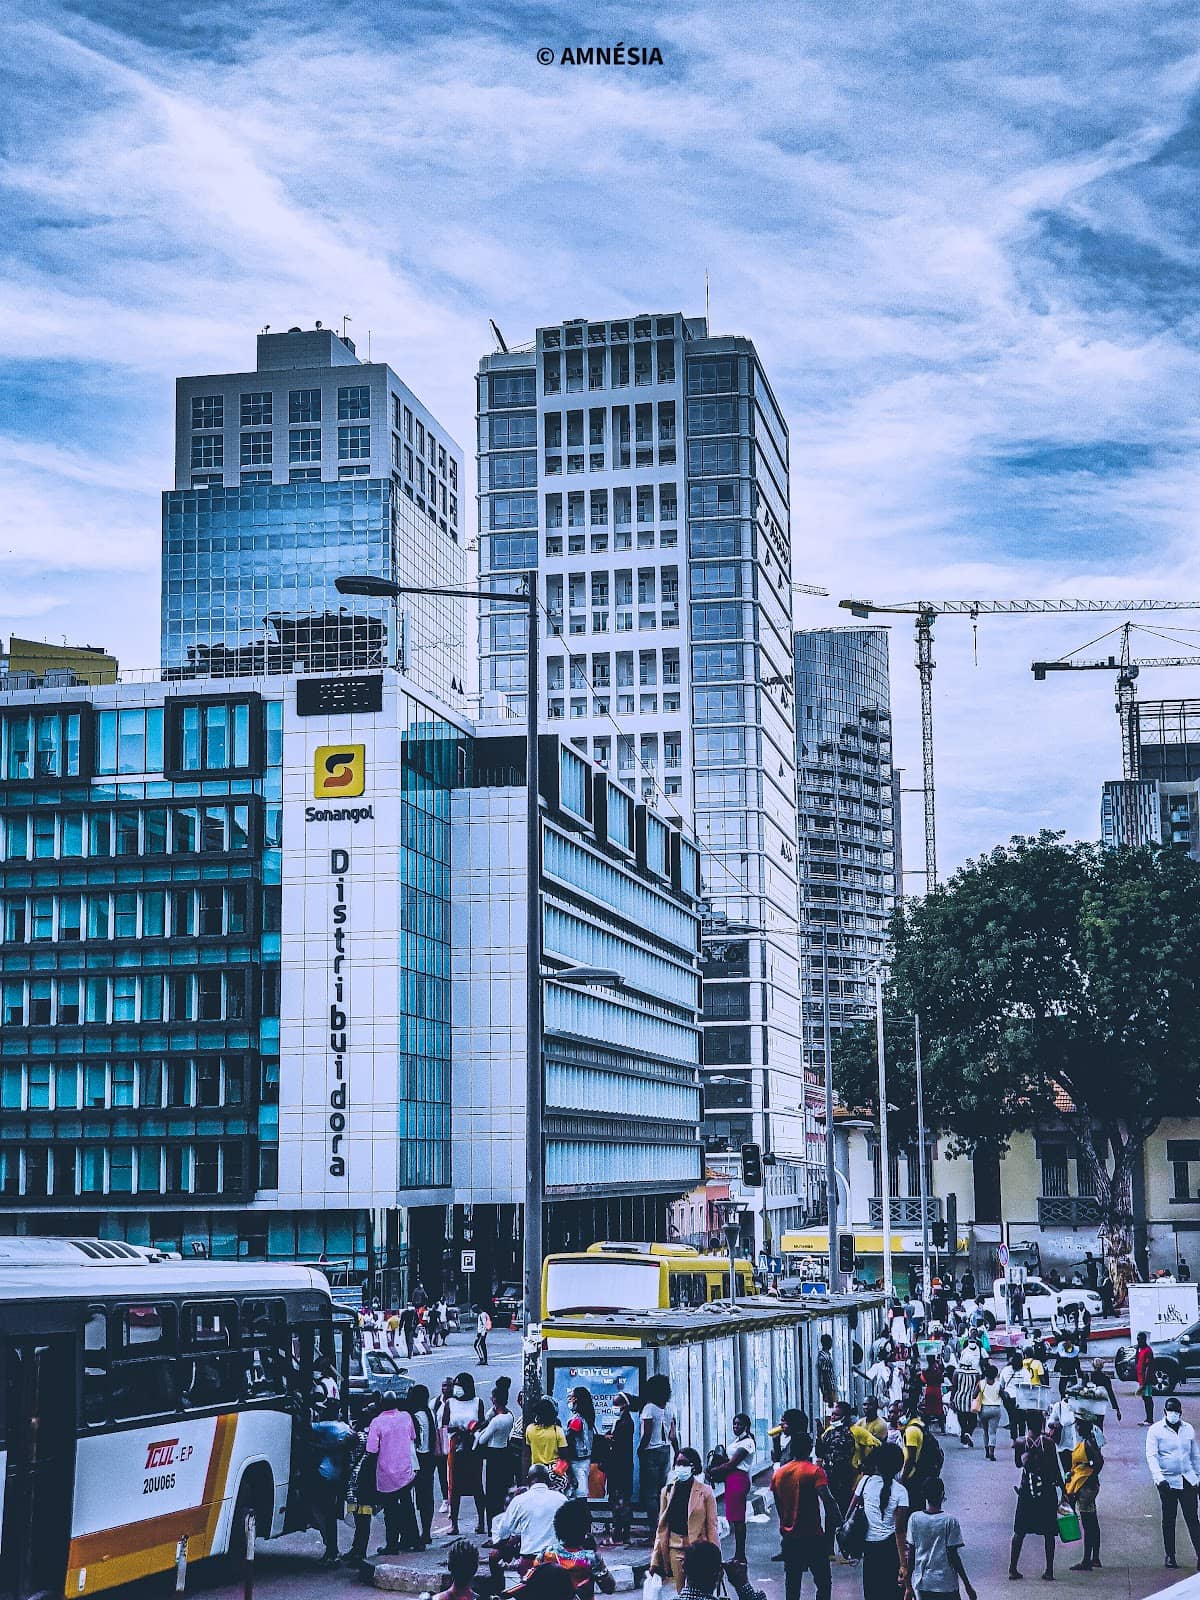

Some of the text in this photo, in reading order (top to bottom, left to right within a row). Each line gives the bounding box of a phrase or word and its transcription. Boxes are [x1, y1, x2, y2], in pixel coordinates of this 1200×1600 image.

[304, 804, 375, 824] Sonangol
[329, 848, 350, 1178] Distribuidora
[577, 1368, 613, 1376] UNITEL
[142, 1473, 176, 1495] 20U065
